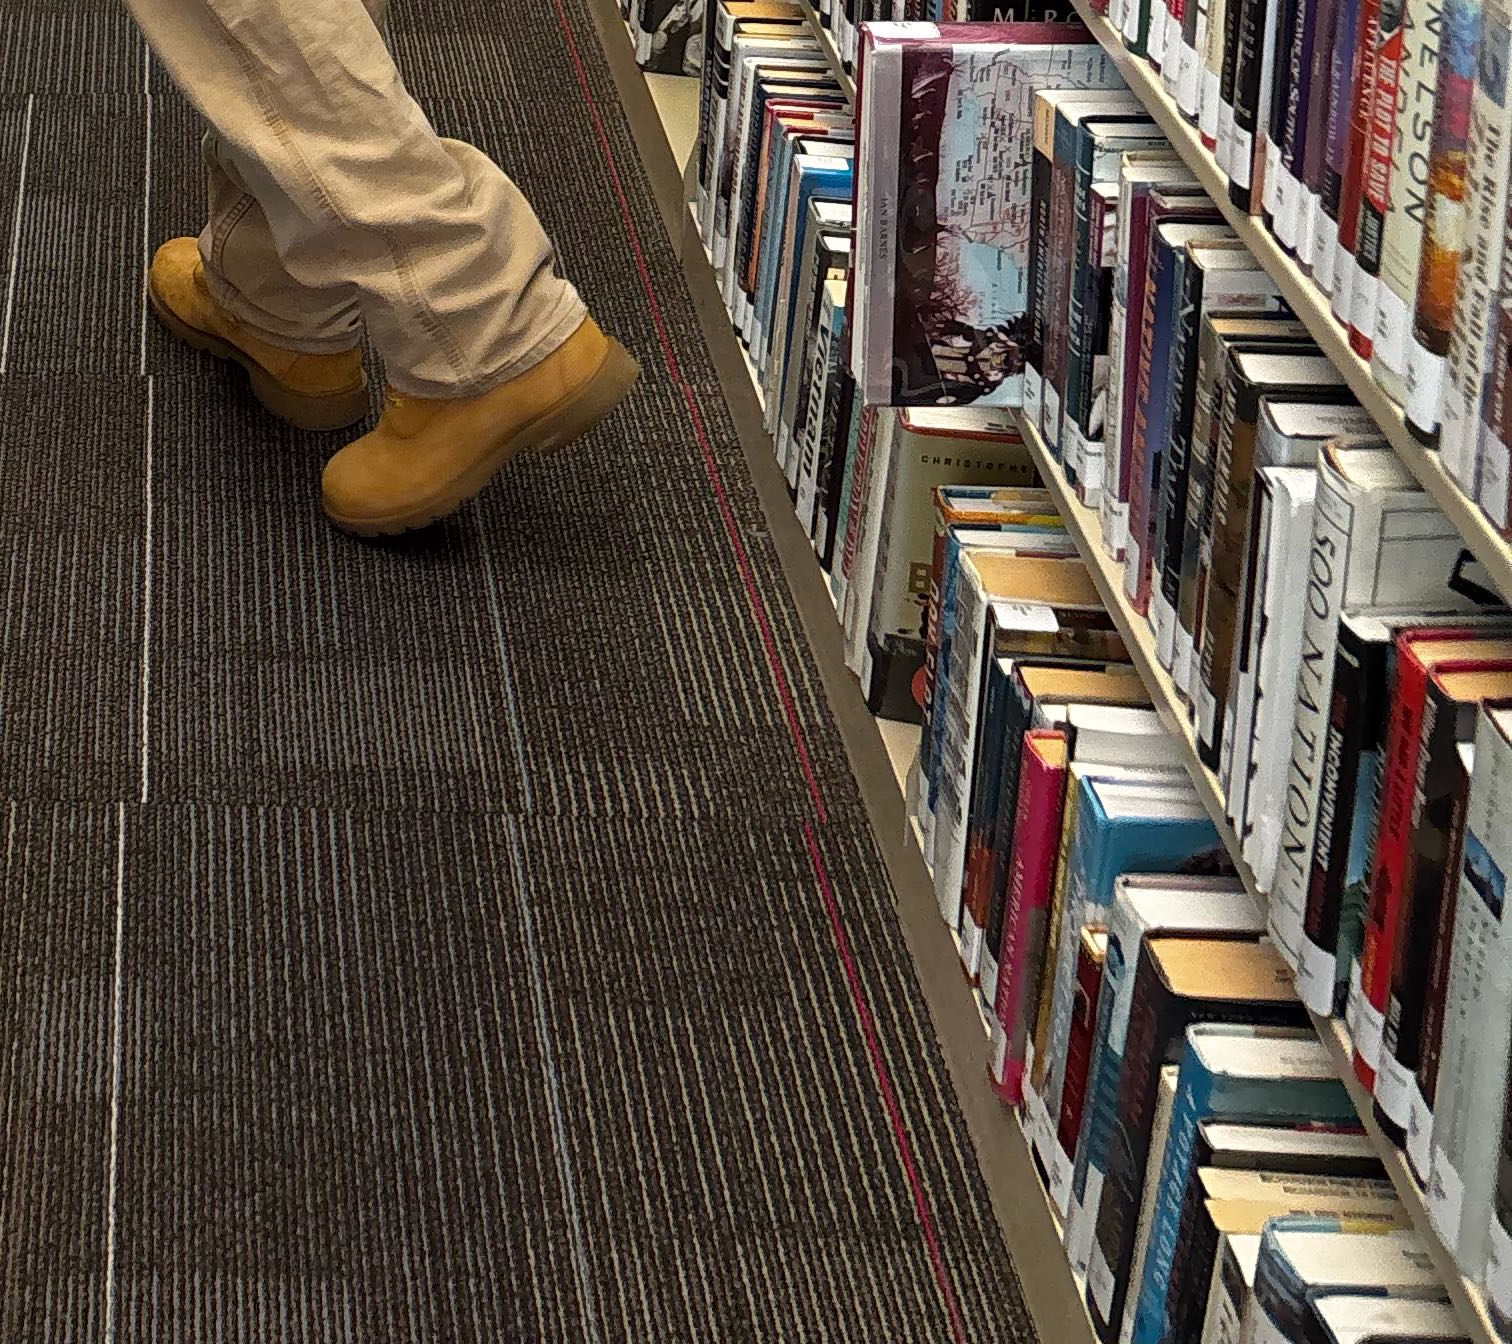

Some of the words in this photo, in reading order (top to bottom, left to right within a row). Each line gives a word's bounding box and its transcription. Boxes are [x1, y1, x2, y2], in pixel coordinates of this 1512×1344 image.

[1373, 84, 1394, 131] PLOT
[1404, 0, 1443, 225] NELSON
[1366, 160, 1387, 205] SAVE
[1314, 729, 1344, 874] INCONVENIENT
